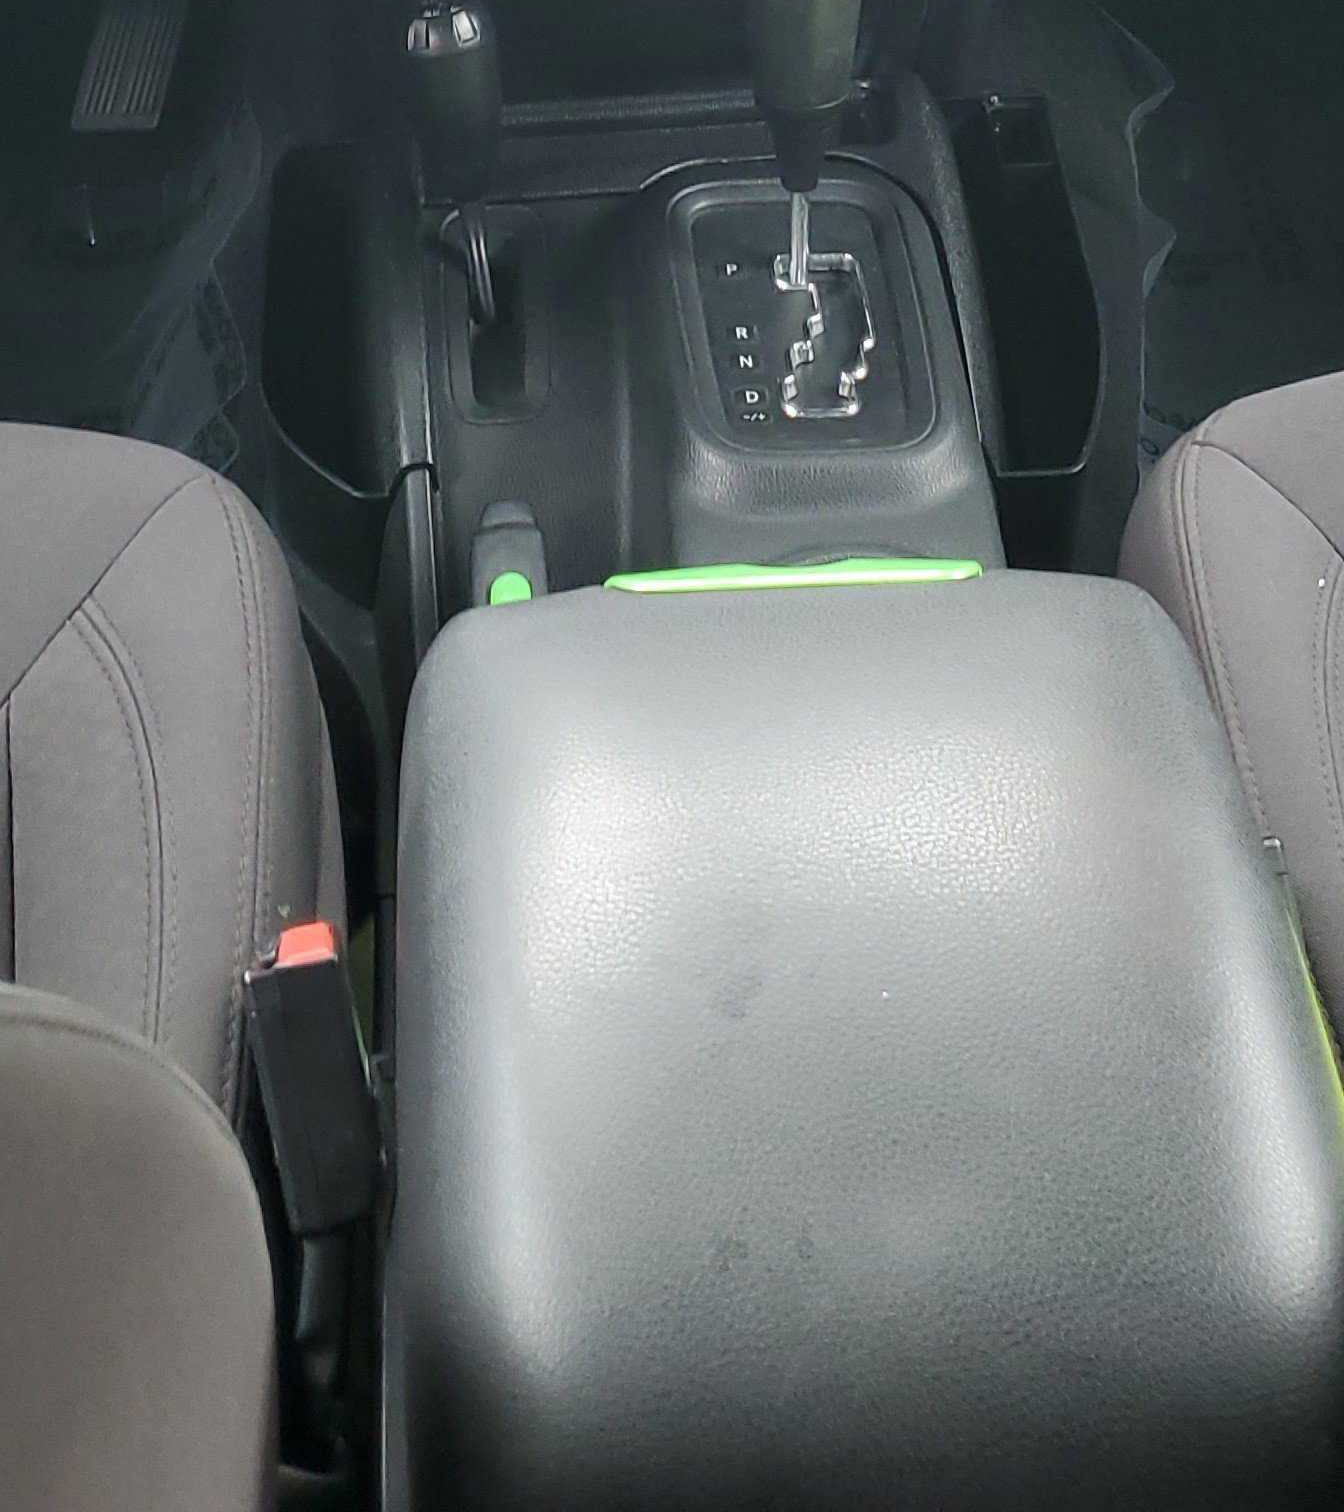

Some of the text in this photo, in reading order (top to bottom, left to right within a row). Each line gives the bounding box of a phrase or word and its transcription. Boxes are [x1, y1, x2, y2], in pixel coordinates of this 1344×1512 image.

[726, 263, 738, 276] P
[736, 326, 748, 339] R
[739, 355, 752, 368] N
[745, 390, 759, 403] D
